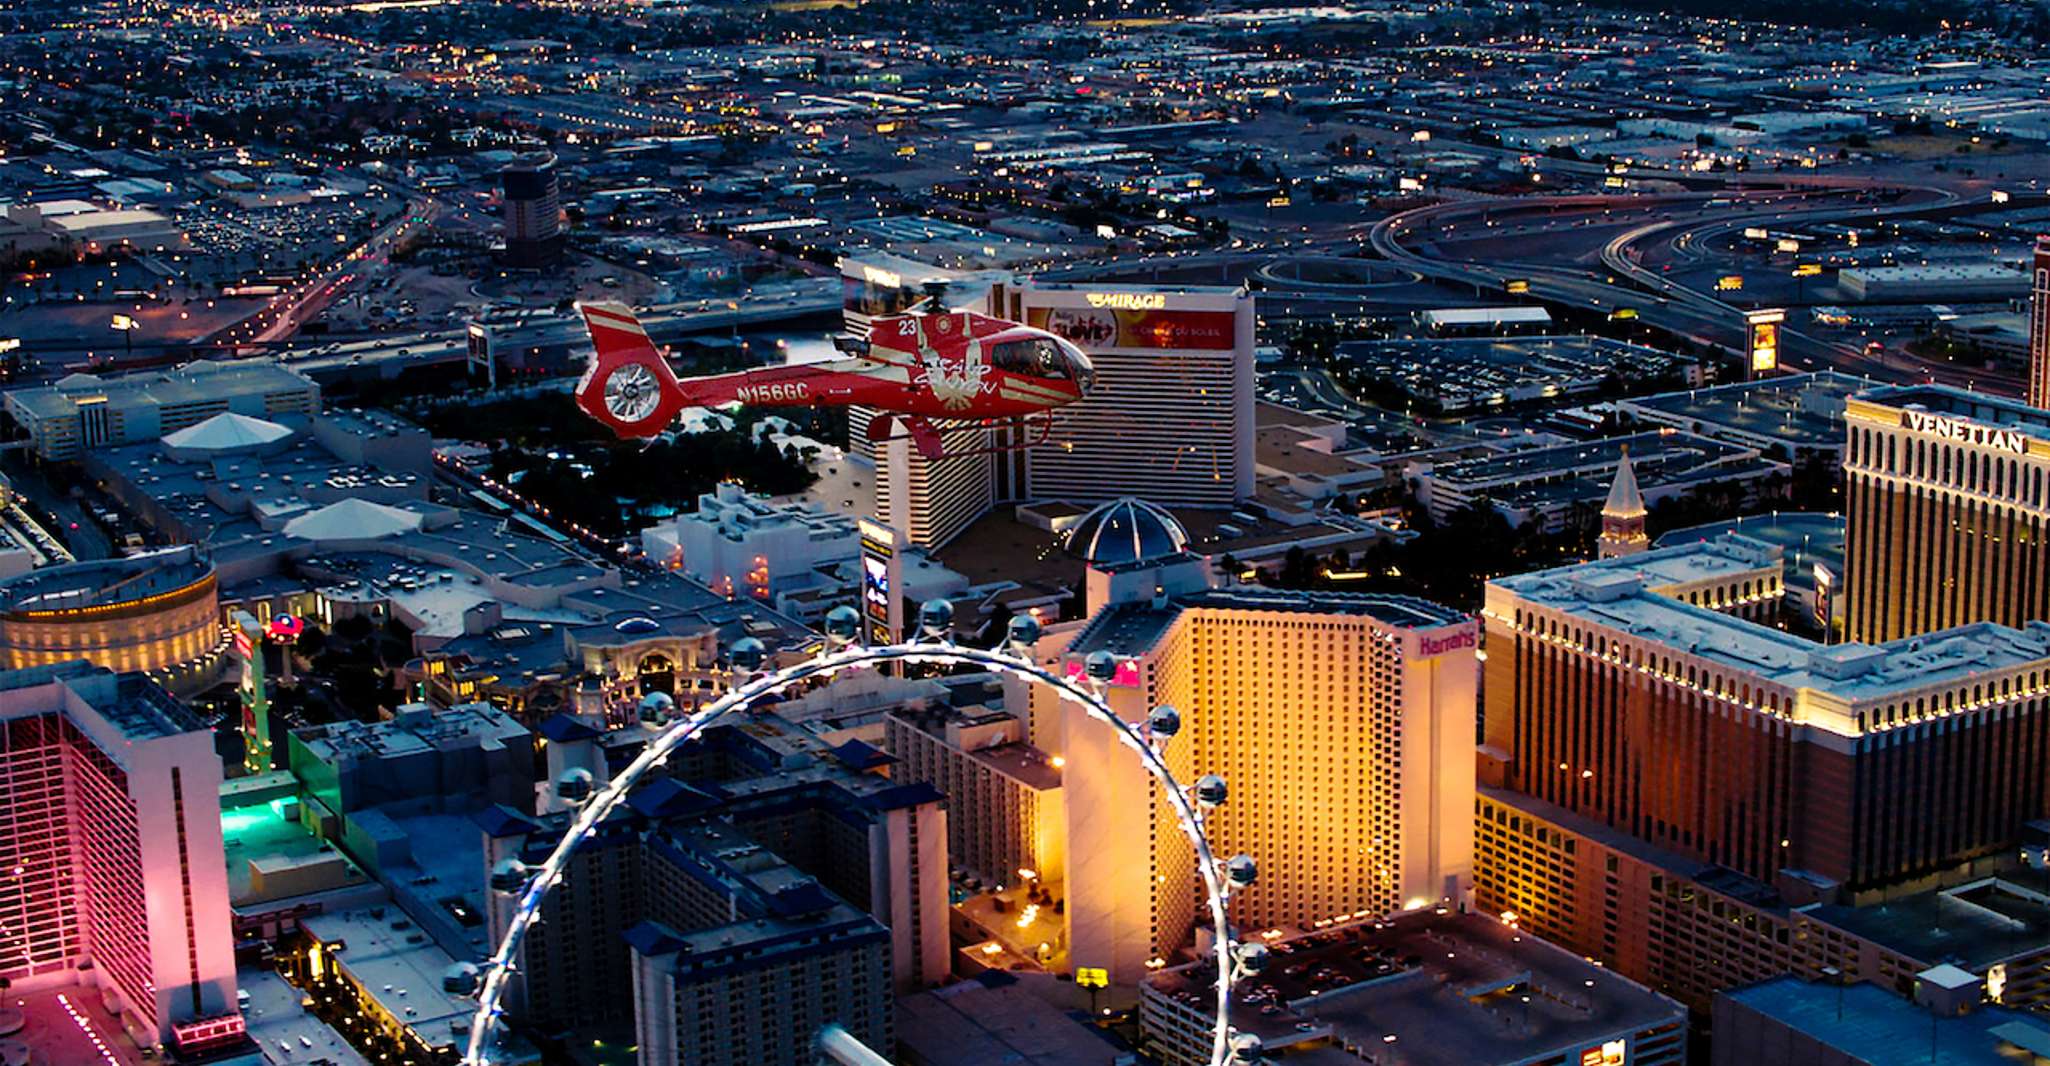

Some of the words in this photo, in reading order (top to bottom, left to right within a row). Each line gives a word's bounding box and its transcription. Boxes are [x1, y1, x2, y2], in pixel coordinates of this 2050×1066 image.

[1104, 293, 1166, 310] MIRAGE
[898, 319, 917, 336] 23
[736, 382, 809, 403] N156GC
[1907, 410, 2027, 454] VENETIAN
